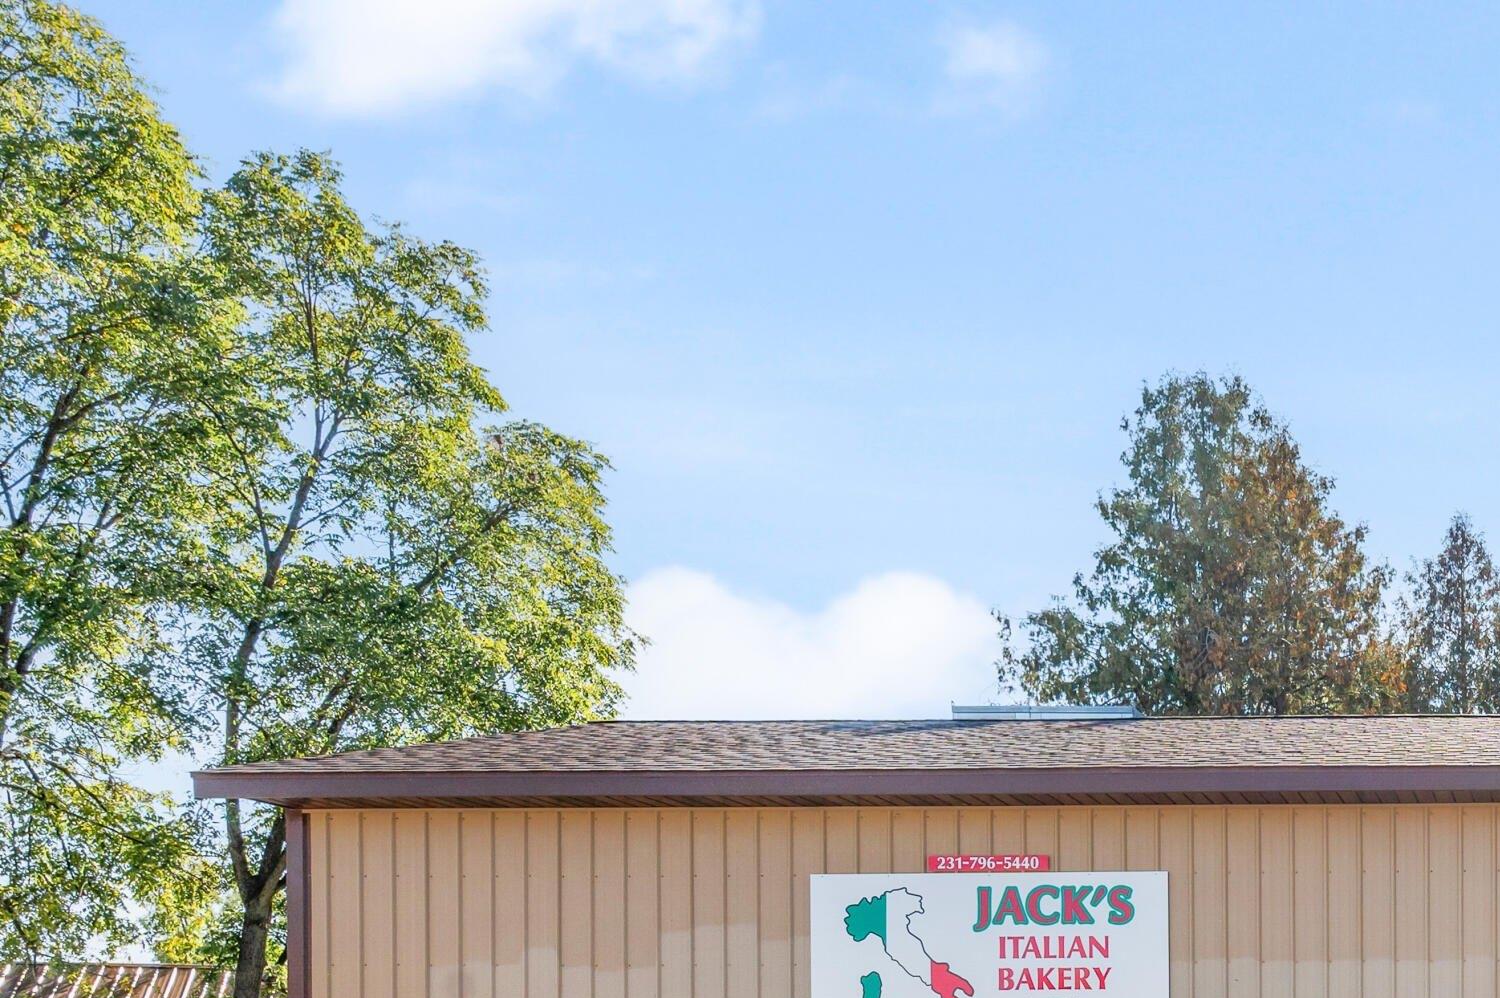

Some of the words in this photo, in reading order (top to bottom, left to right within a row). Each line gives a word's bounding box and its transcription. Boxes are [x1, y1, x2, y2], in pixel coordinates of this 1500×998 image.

[936, 856, 1040, 871] 231-796-5440
[972, 884, 1136, 932] JACK'S
[998, 935, 1110, 959] ITALIAN
[998, 967, 1112, 991] BAKERY
